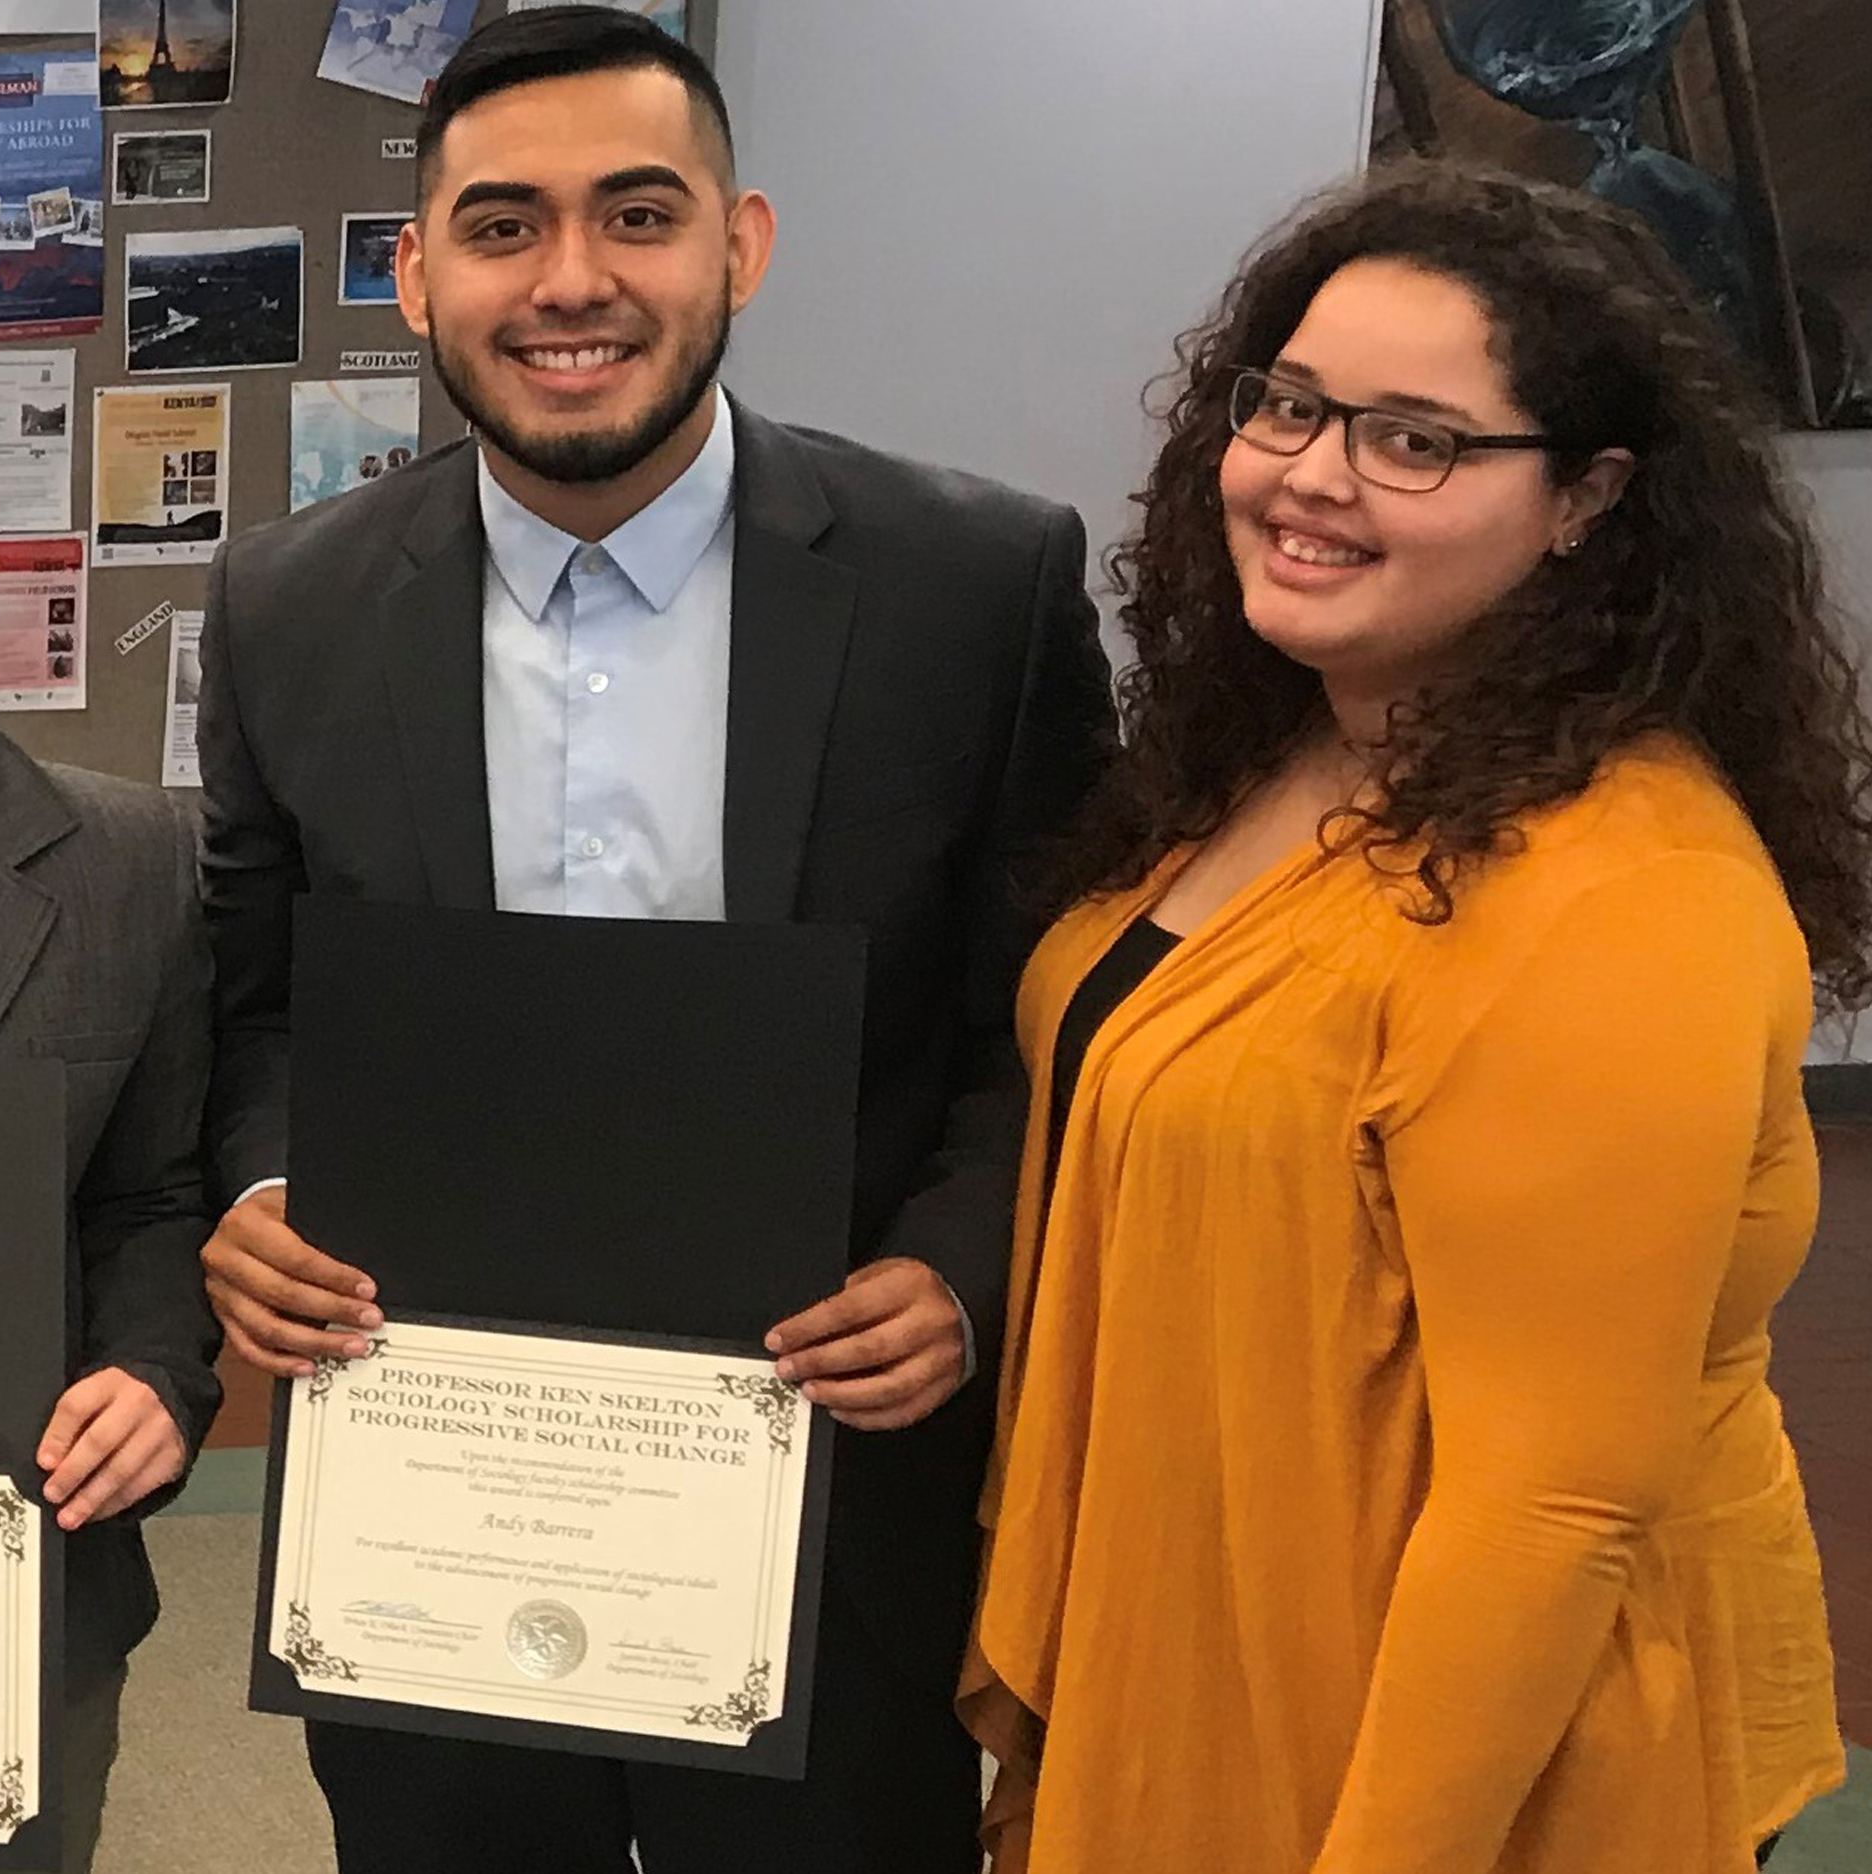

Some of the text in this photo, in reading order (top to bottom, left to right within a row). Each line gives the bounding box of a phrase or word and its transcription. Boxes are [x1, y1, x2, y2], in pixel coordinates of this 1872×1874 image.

[7, 135, 74, 151] ABROAD
[59, 117, 91, 131] FOR
[344, 354, 418, 367] SCOTLAND
[116, 602, 174, 652] ENGLAND
[380, 1367, 724, 1419] PROFESSOR KEN SKELTON
[347, 1386, 751, 1445] SOCIOLOGY SCHOLARSHIP FOR
[349, 1407, 746, 1467] PROGRESSIVE SOCIAL CHANGE
[477, 1512, 595, 1541] Andy Barrera
